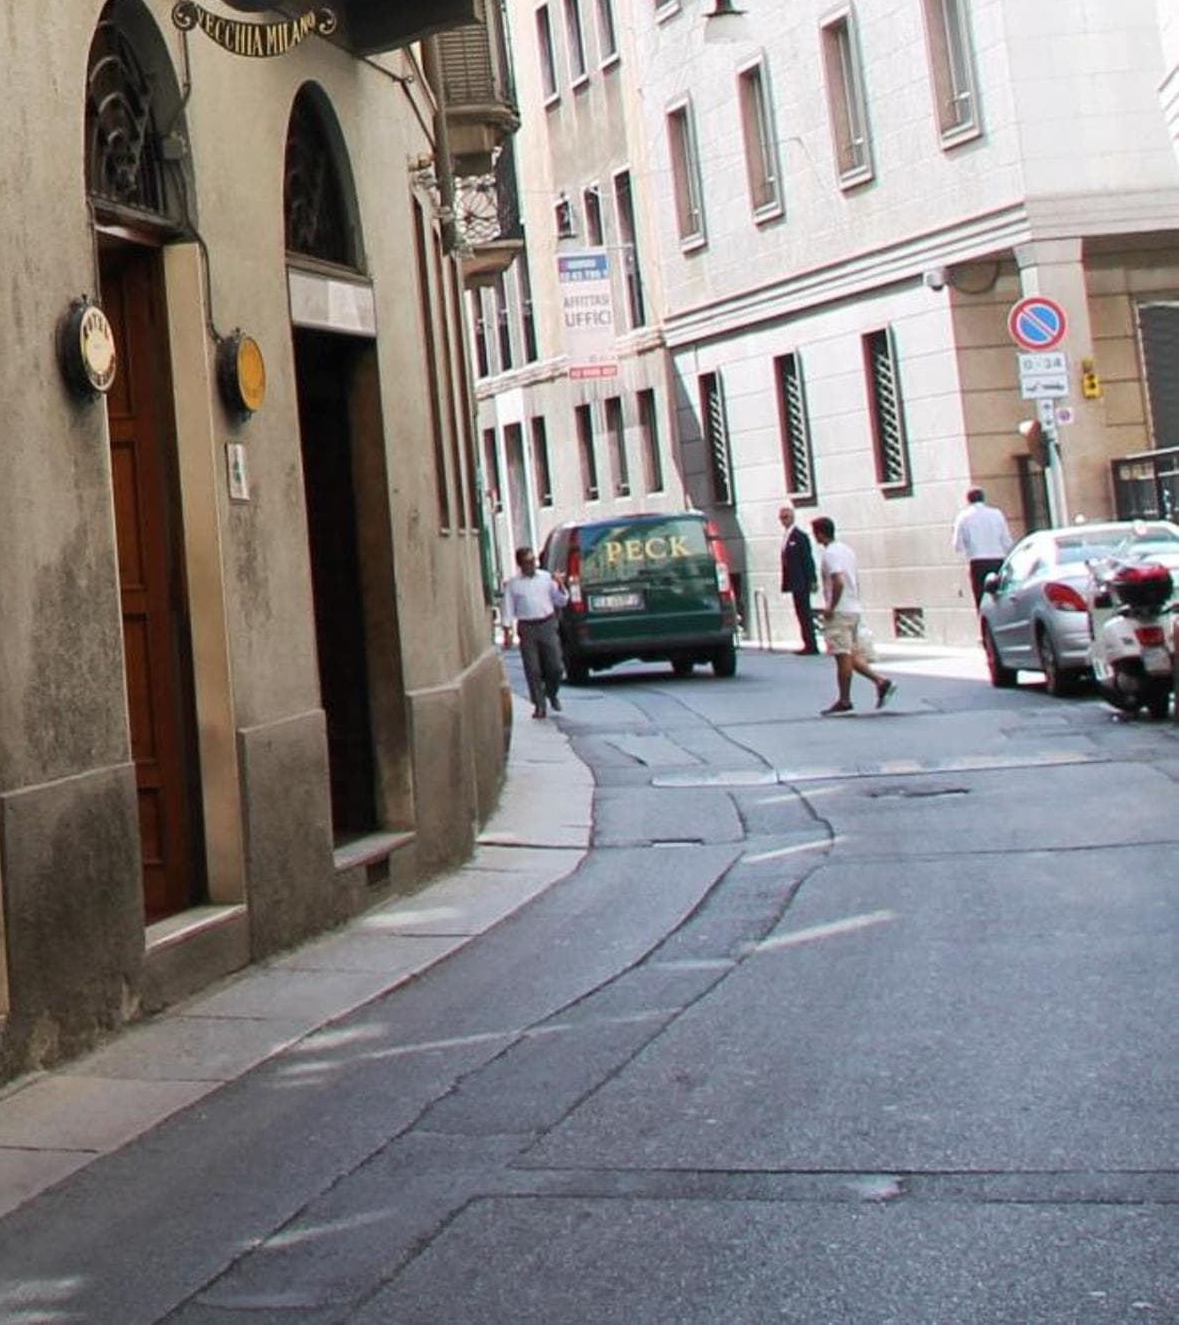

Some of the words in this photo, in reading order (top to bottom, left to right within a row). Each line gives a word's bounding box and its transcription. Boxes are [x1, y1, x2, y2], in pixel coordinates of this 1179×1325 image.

[197, 8, 264, 56] VECCHIA
[265, 10, 316, 55] MILANO
[605, 535, 692, 563] PECK
